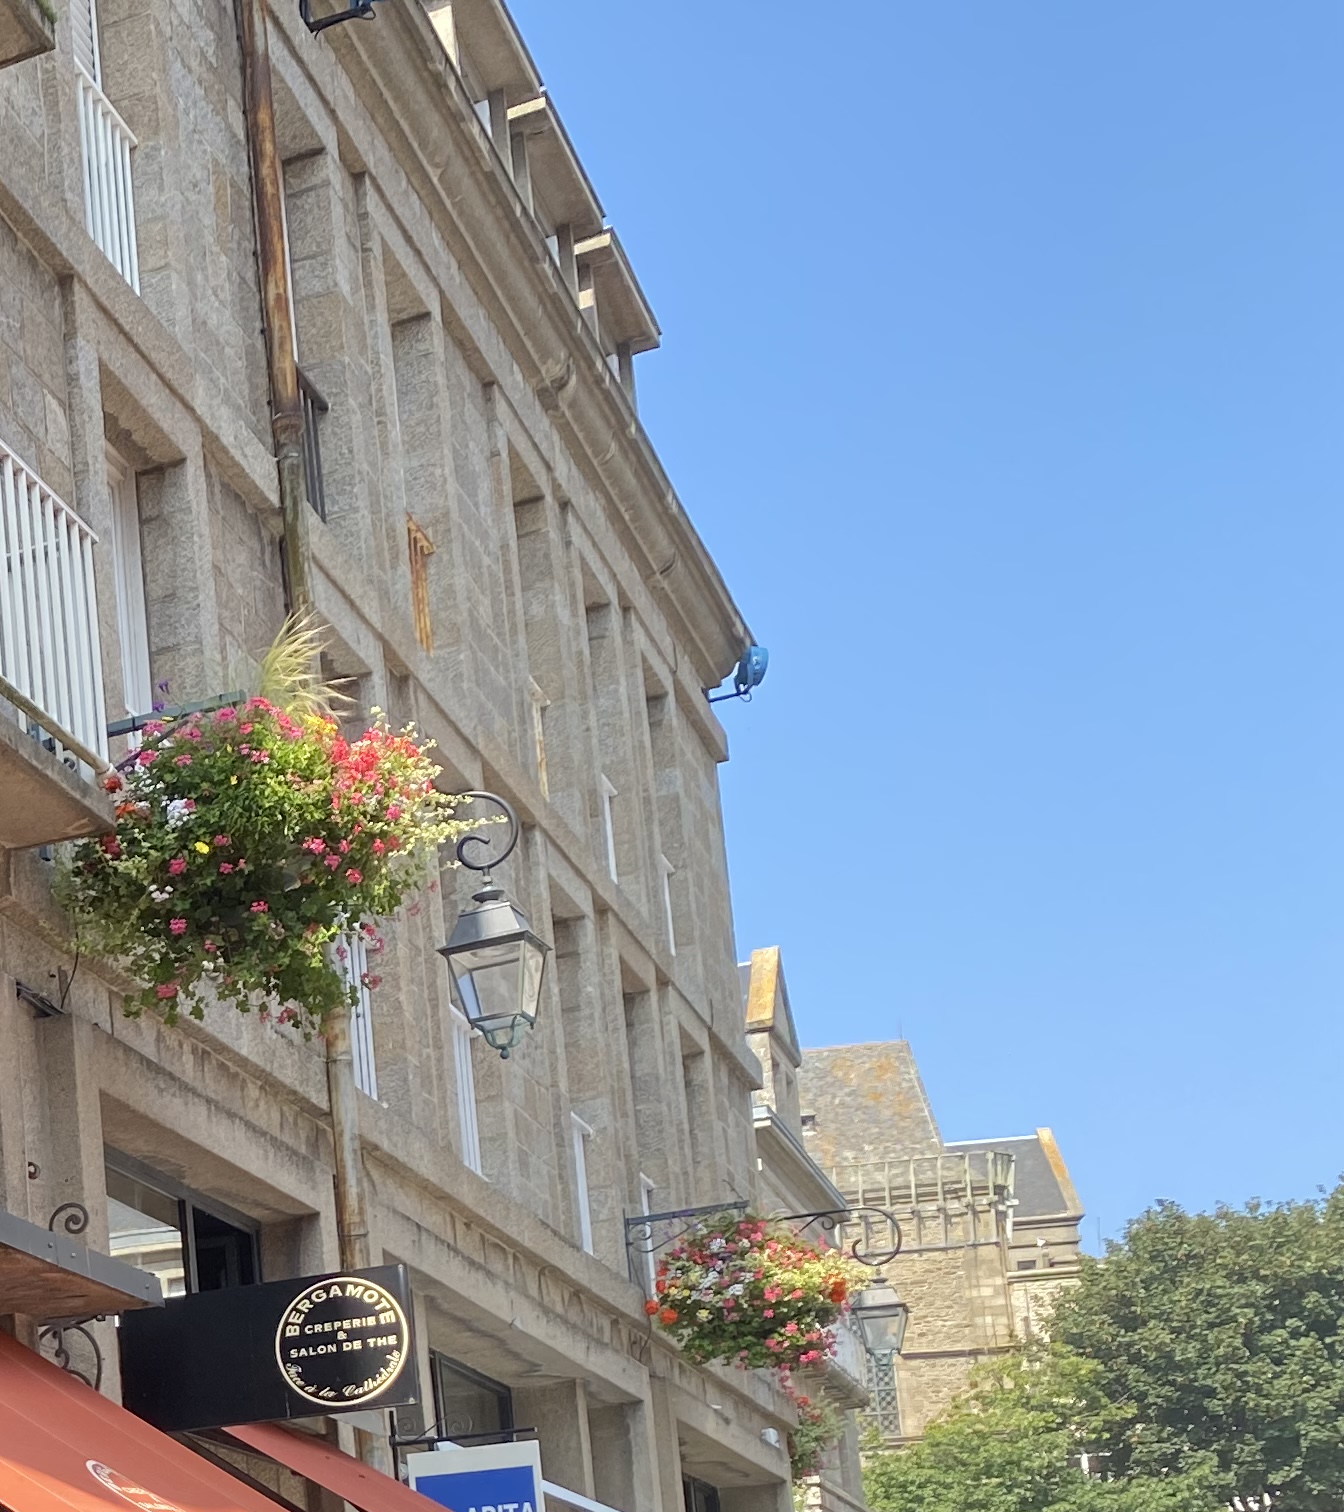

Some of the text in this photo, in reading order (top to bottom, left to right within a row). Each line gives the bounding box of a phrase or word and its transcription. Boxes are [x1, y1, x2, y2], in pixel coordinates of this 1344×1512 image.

[285, 1283, 397, 1338] BERGAMOTE
[304, 1318, 376, 1335] CREPERIE
[337, 1330, 348, 1340] &
[289, 1334, 398, 1359] SALON DE THE
